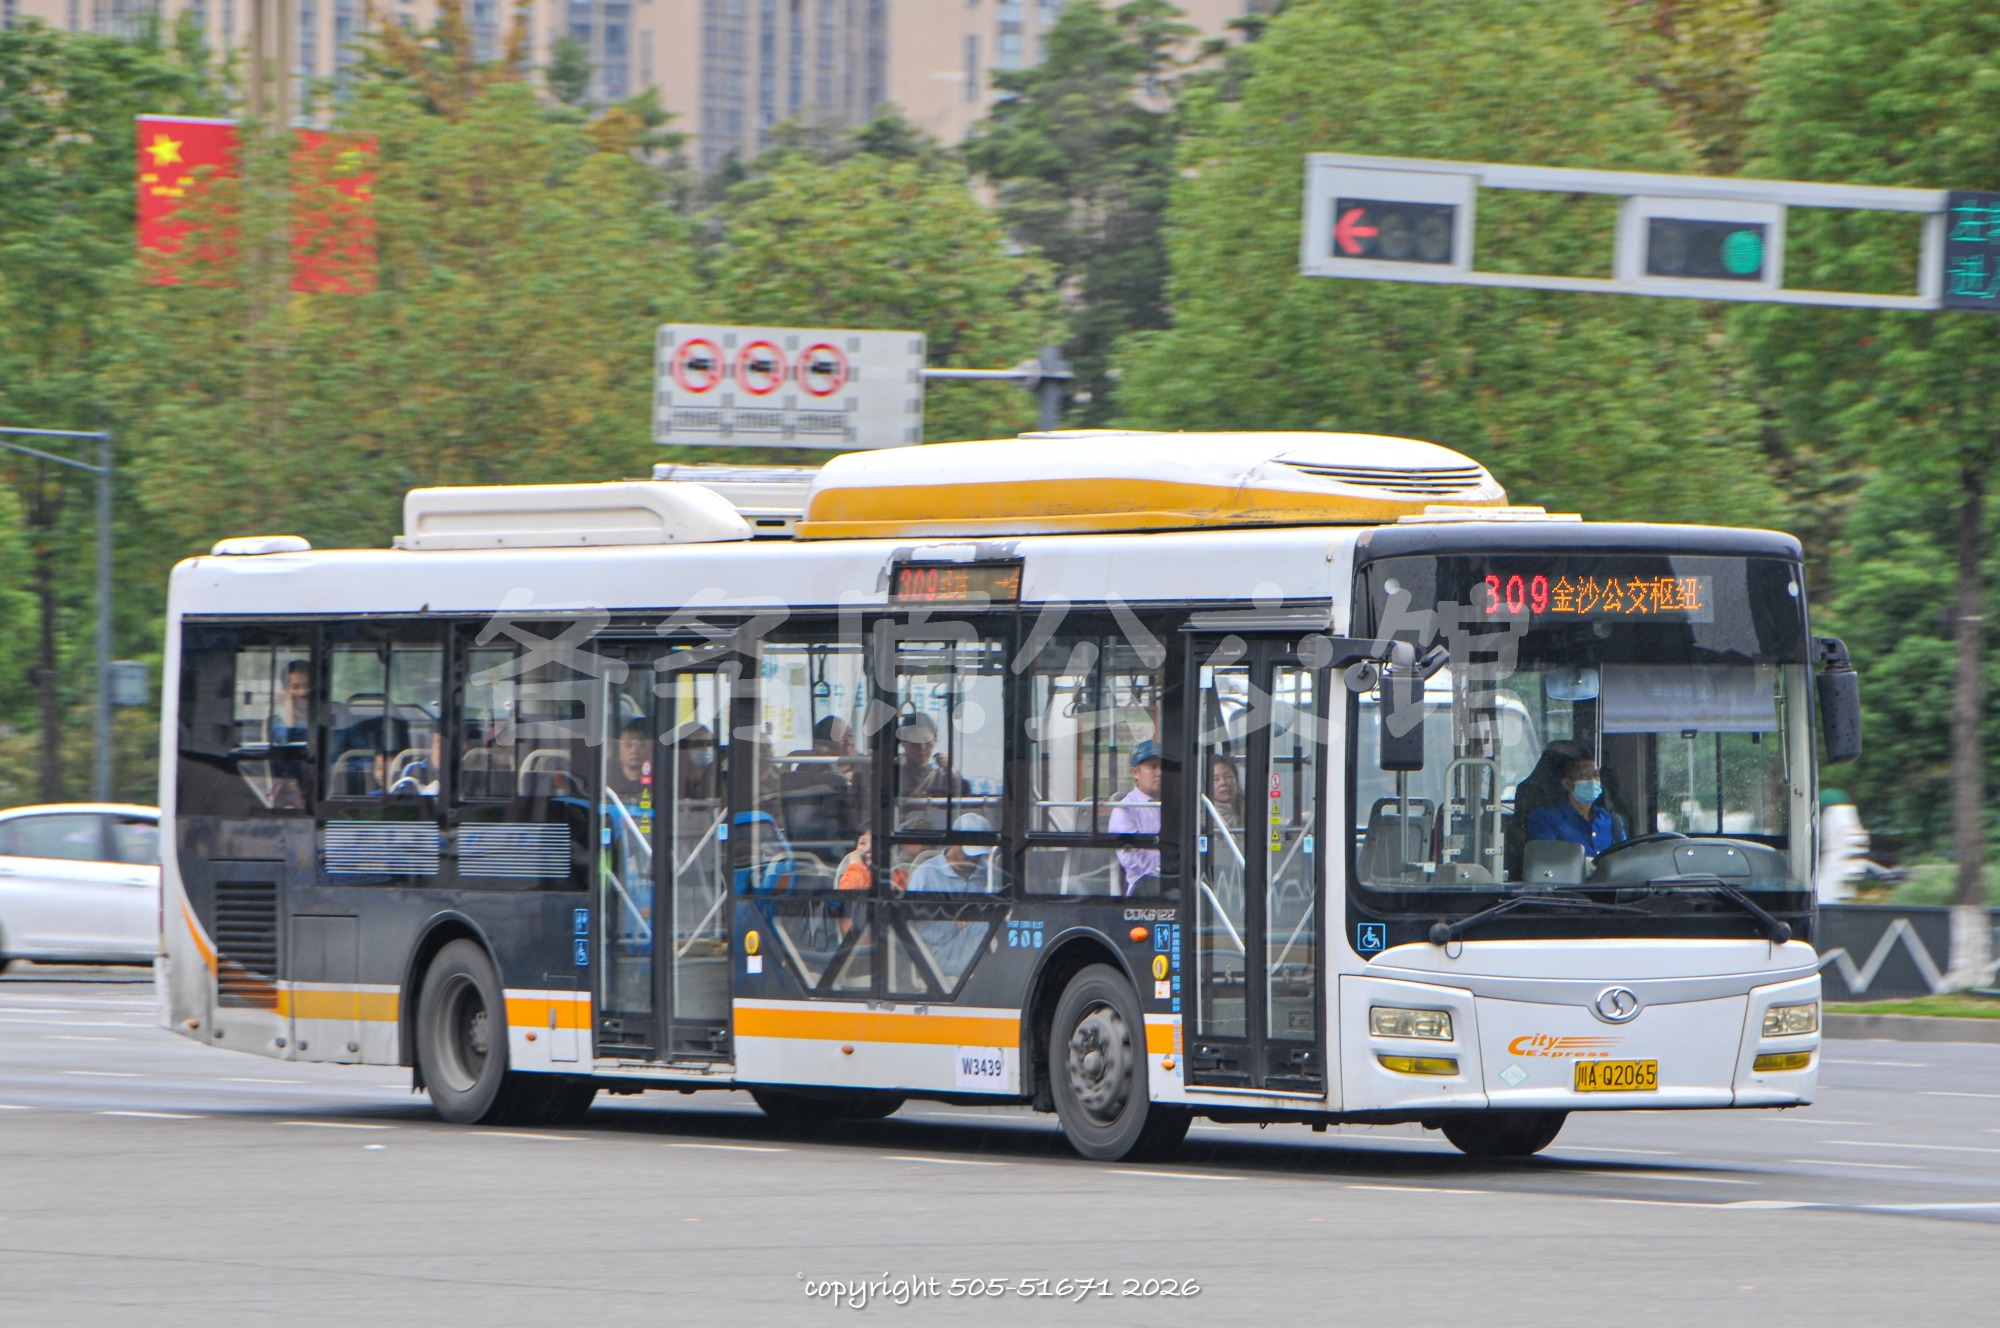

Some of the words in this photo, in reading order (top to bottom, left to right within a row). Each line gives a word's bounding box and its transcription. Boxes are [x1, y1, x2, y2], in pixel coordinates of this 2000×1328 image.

[898, 568, 938, 602] 309
[1485, 575, 1548, 614] 309
[1552, 576, 1699, 614] 金沙公交枢纽
[1508, 1033, 1559, 1055] City
[1525, 1049, 1610, 1058] Express
[962, 1057, 1002, 1077] W3439
